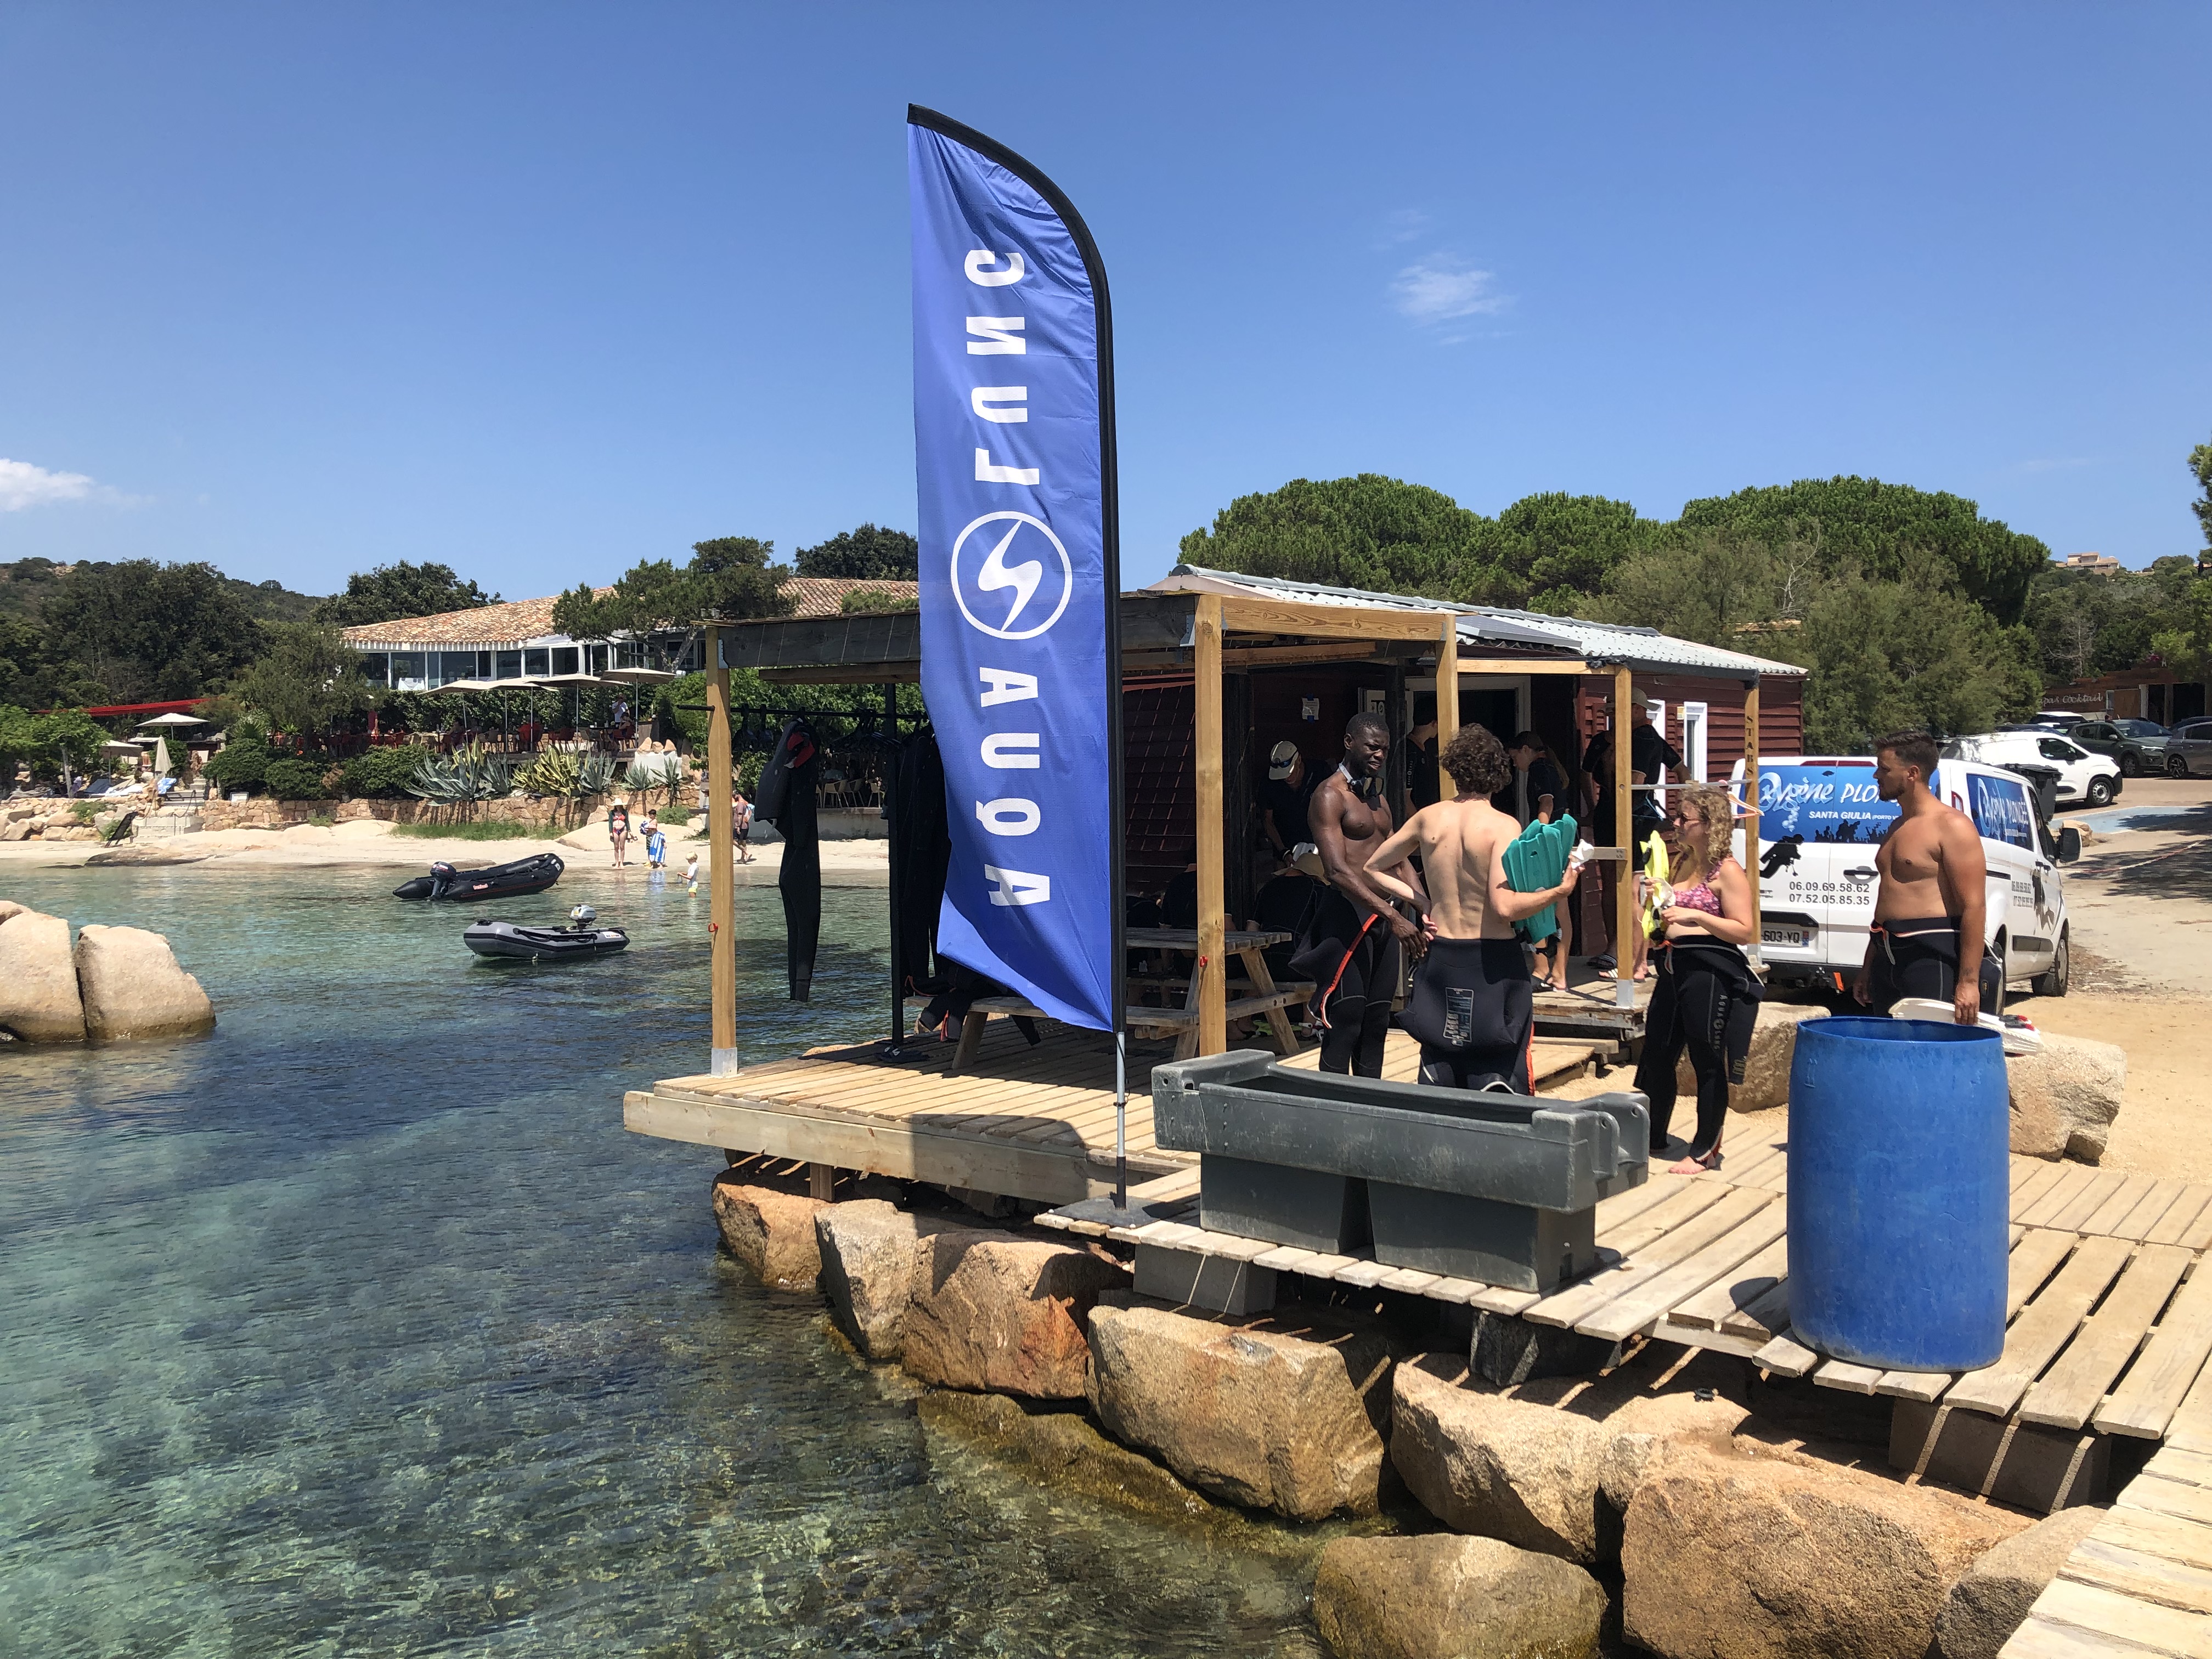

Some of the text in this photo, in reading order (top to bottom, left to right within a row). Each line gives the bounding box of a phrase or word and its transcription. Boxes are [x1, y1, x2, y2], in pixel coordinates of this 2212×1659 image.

[2036, 696, 2059, 707] apas
[1840, 811, 1871, 820] GIULIA
[1789, 881, 1870, 893] 06.09.69.58.62
[1788, 893, 1870, 905] 07.52.05.85.35
